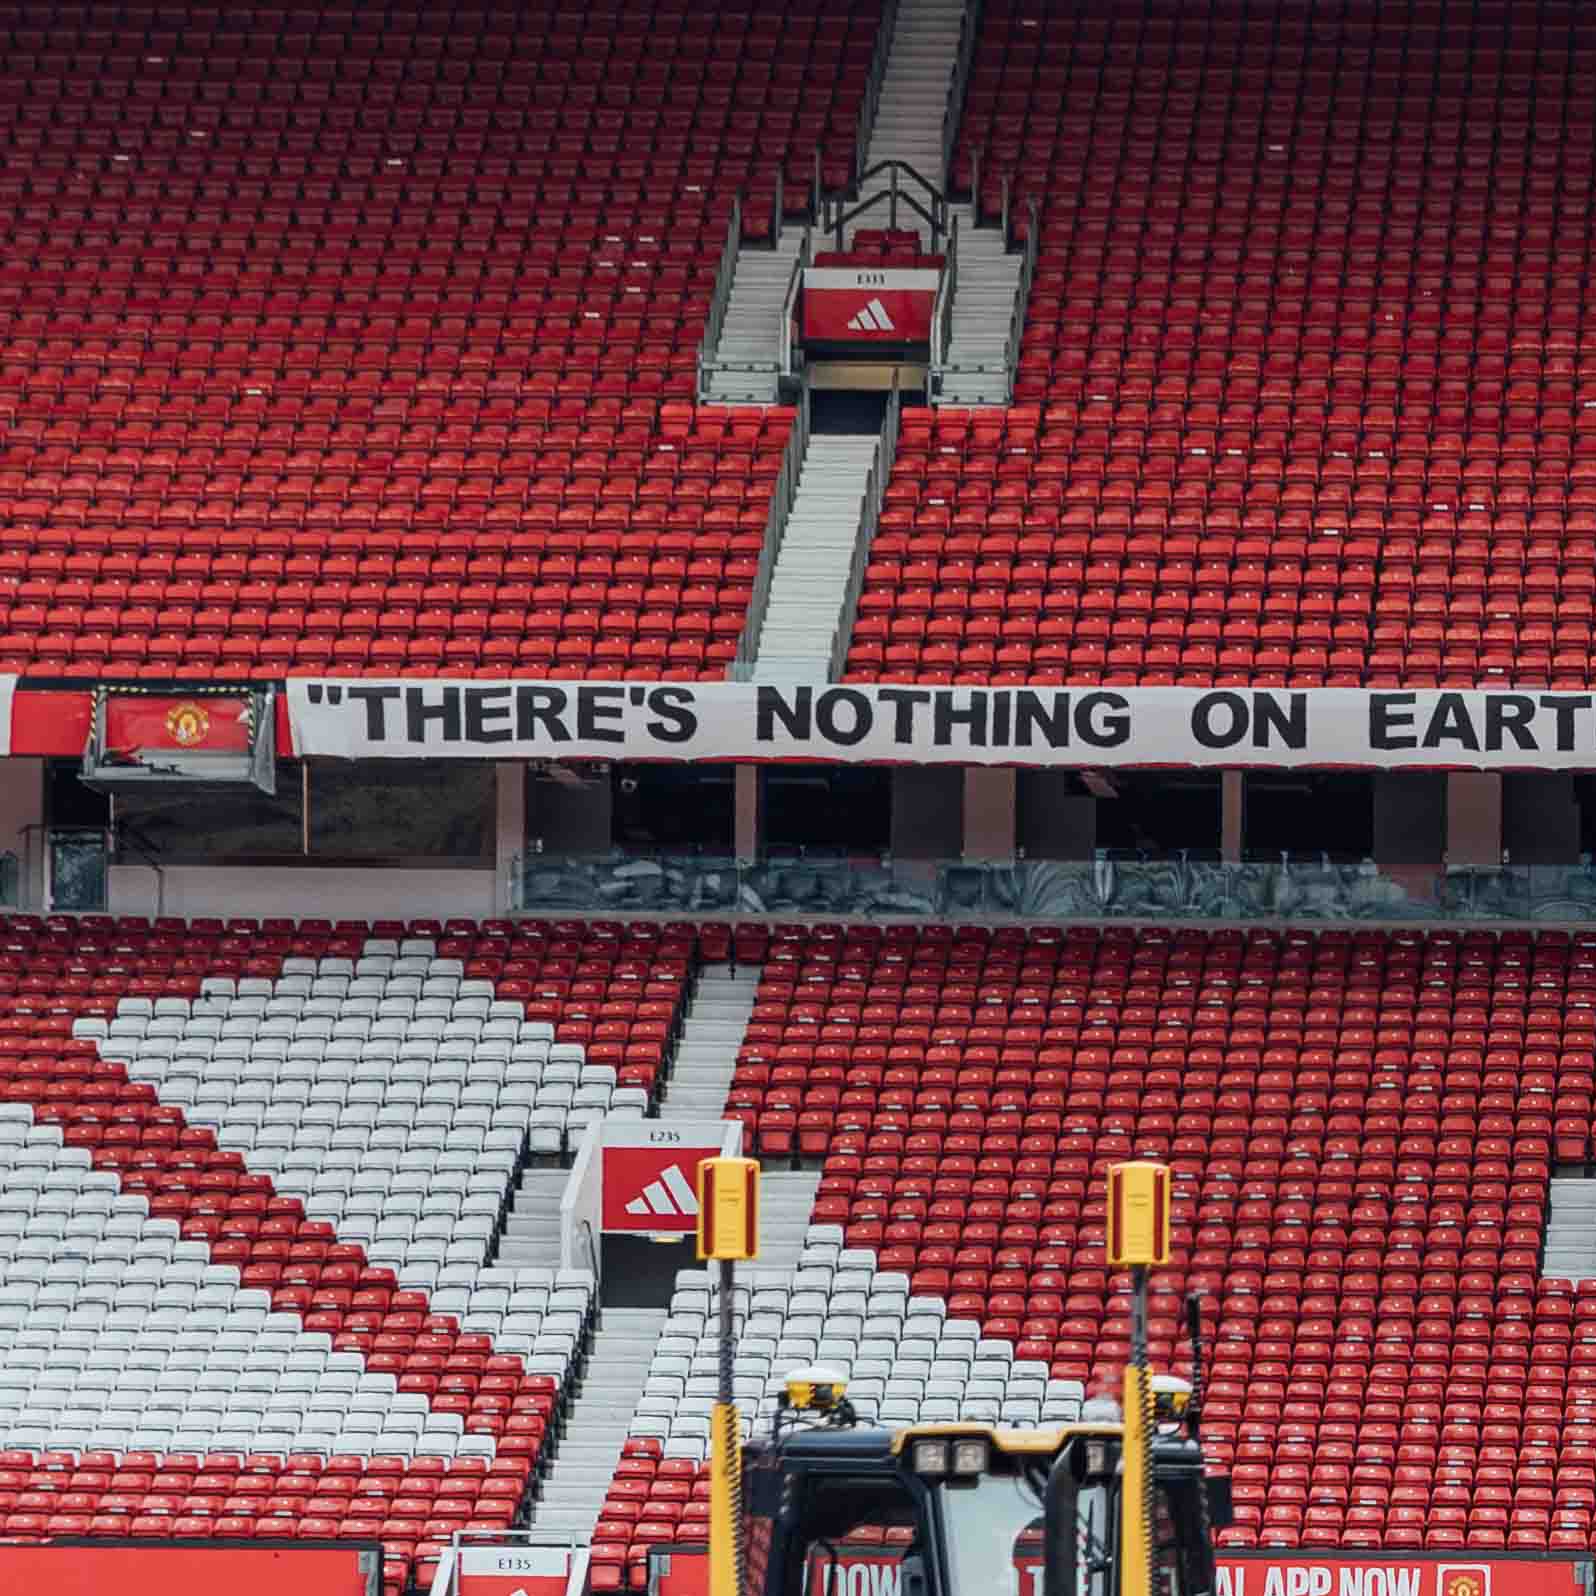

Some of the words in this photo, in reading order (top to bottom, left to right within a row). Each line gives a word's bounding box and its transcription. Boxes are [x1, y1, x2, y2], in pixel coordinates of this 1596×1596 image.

[307, 684, 697, 745] "THERE'S
[755, 686, 1131, 749] NOTHING
[1191, 690, 1307, 749] ON
[498, 1559, 531, 1570] E135
